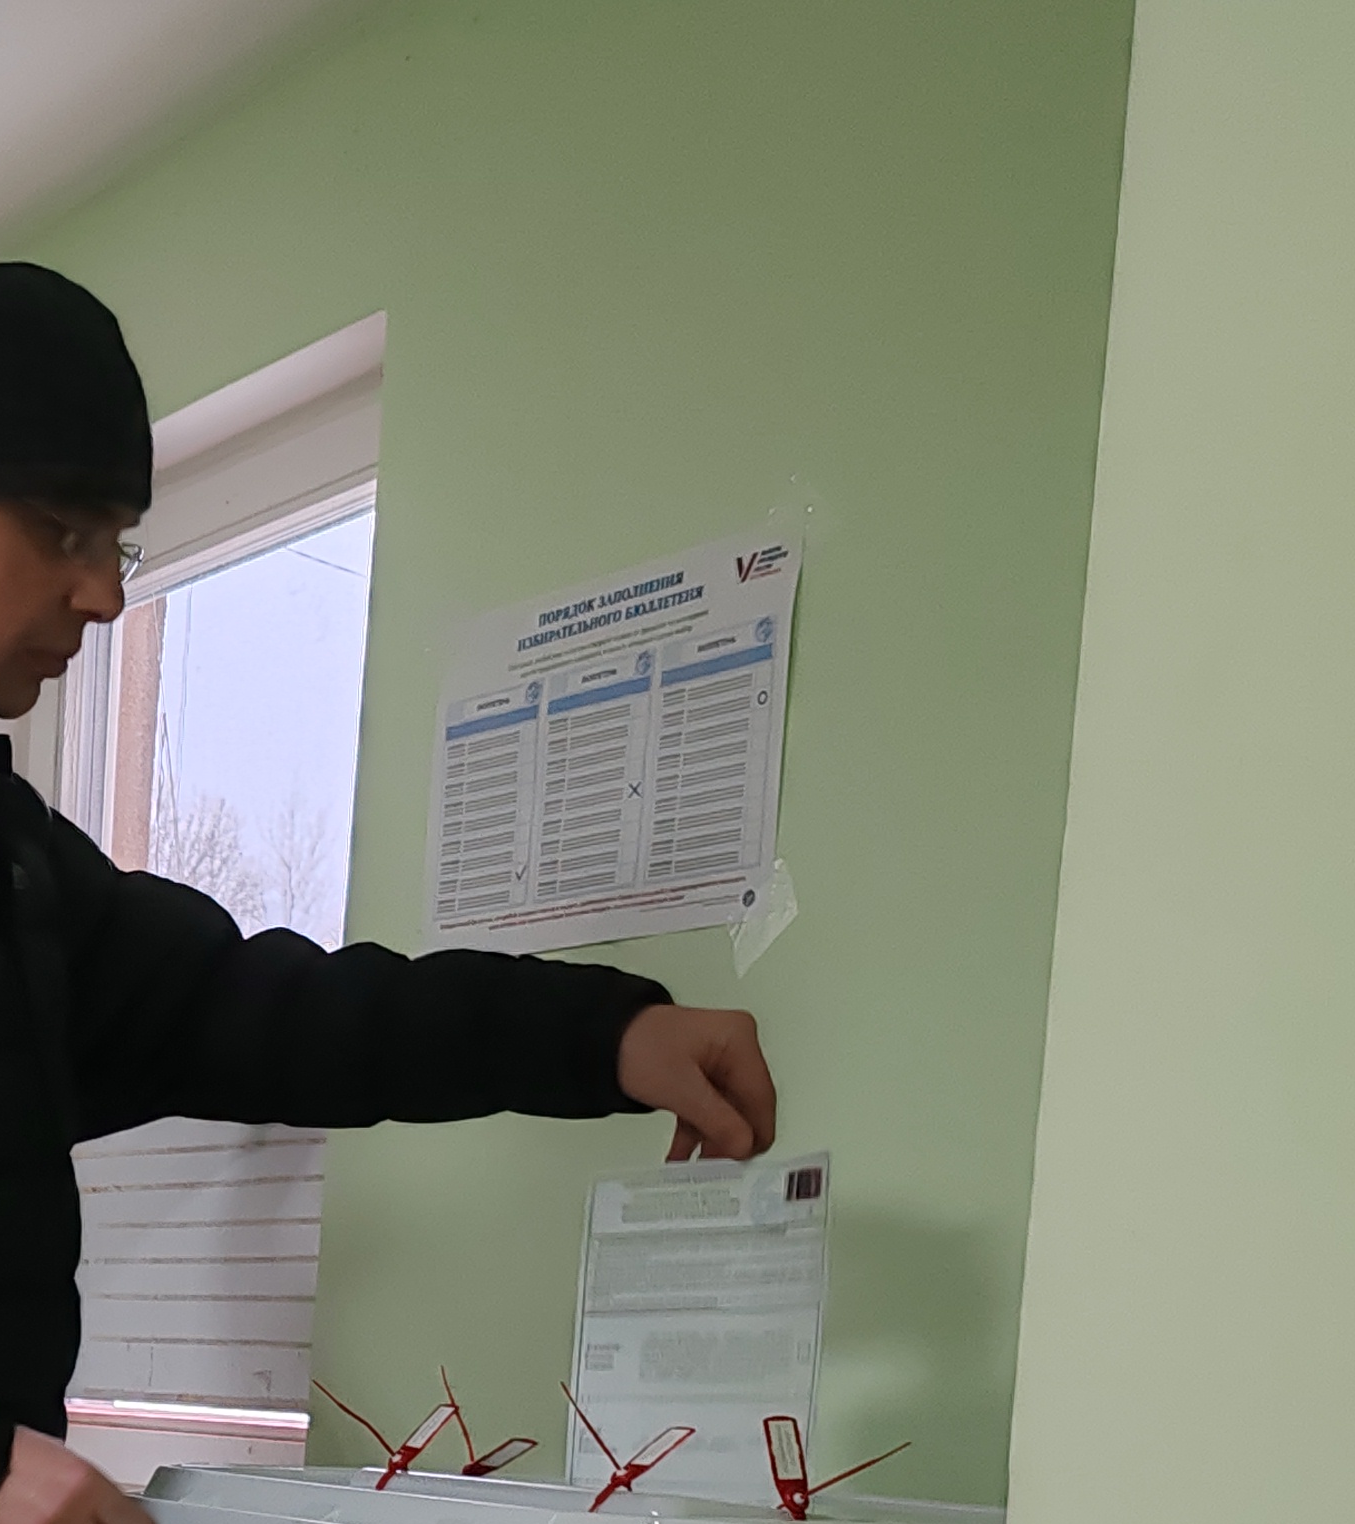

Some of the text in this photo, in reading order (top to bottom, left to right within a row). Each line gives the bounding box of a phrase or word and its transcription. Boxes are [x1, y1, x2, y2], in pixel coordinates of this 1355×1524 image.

[539, 571, 684, 627] ПОРЯДОК ЗАПОЛНЕНИЯ
[517, 608, 622, 652] ИЗБИРАТЕЛЬНОГО
